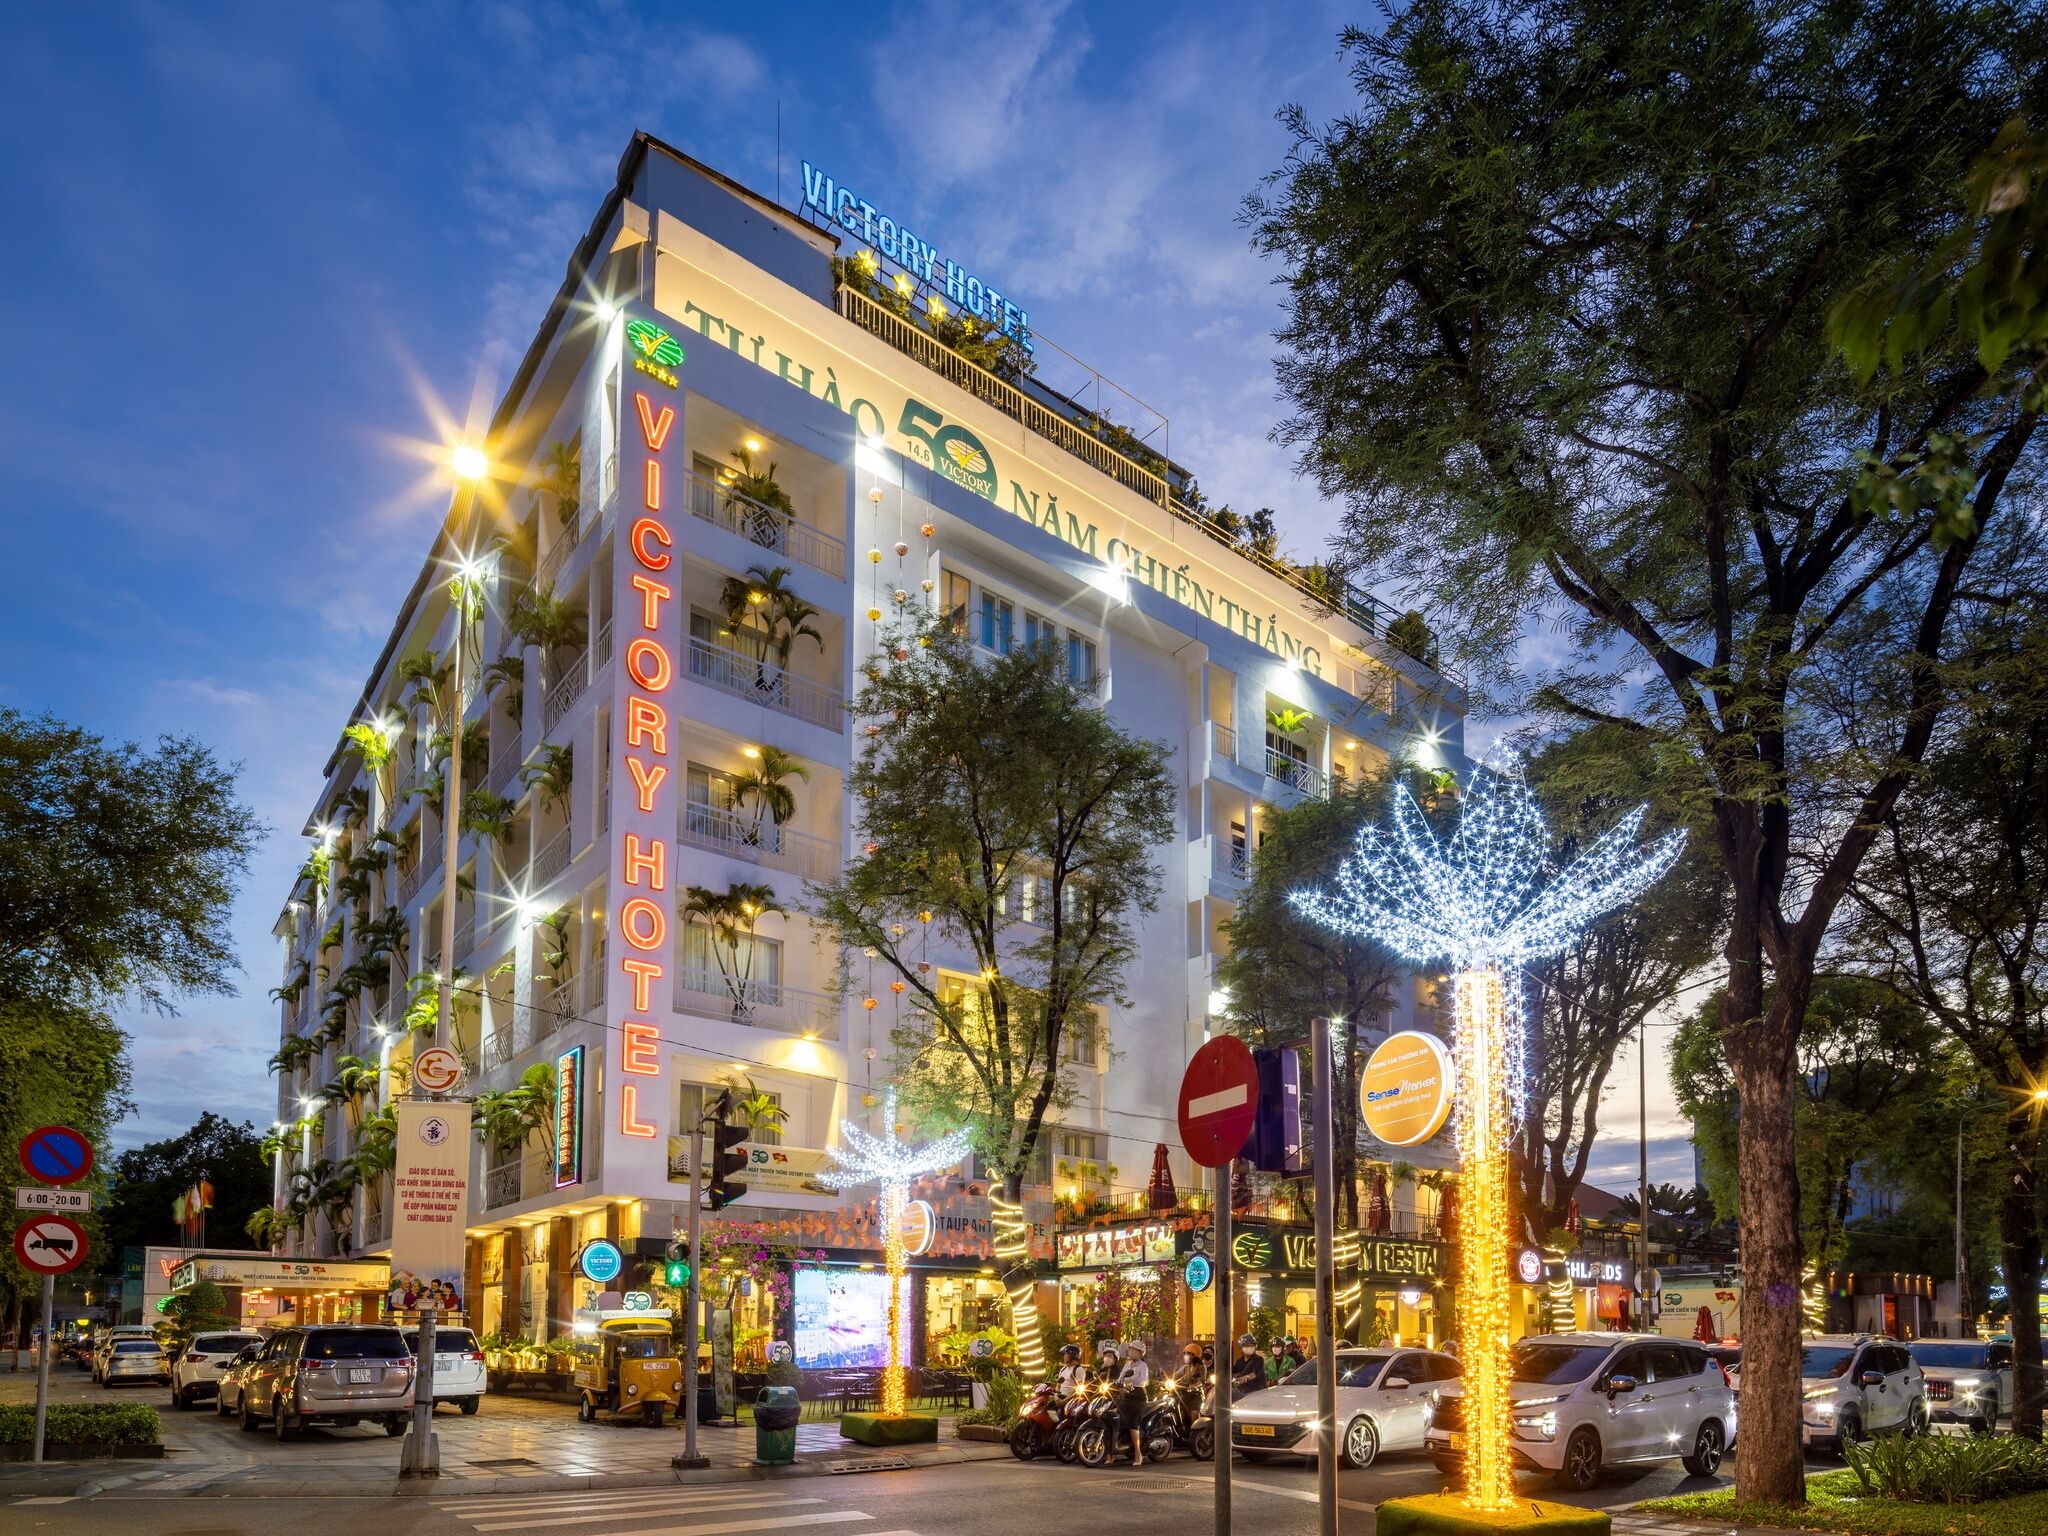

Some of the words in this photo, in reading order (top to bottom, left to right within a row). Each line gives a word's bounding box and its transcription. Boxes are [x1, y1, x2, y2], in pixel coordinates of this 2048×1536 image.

[801, 160, 938, 284] VICTORY
[946, 258, 1034, 354] HOTEL
[907, 440, 930, 461] 14.6
[940, 456, 992, 495] VICTORY
[1010, 480, 1098, 557] NĂM
[626, 391, 675, 812] VICTORY
[621, 833, 667, 1138] HOTEL
